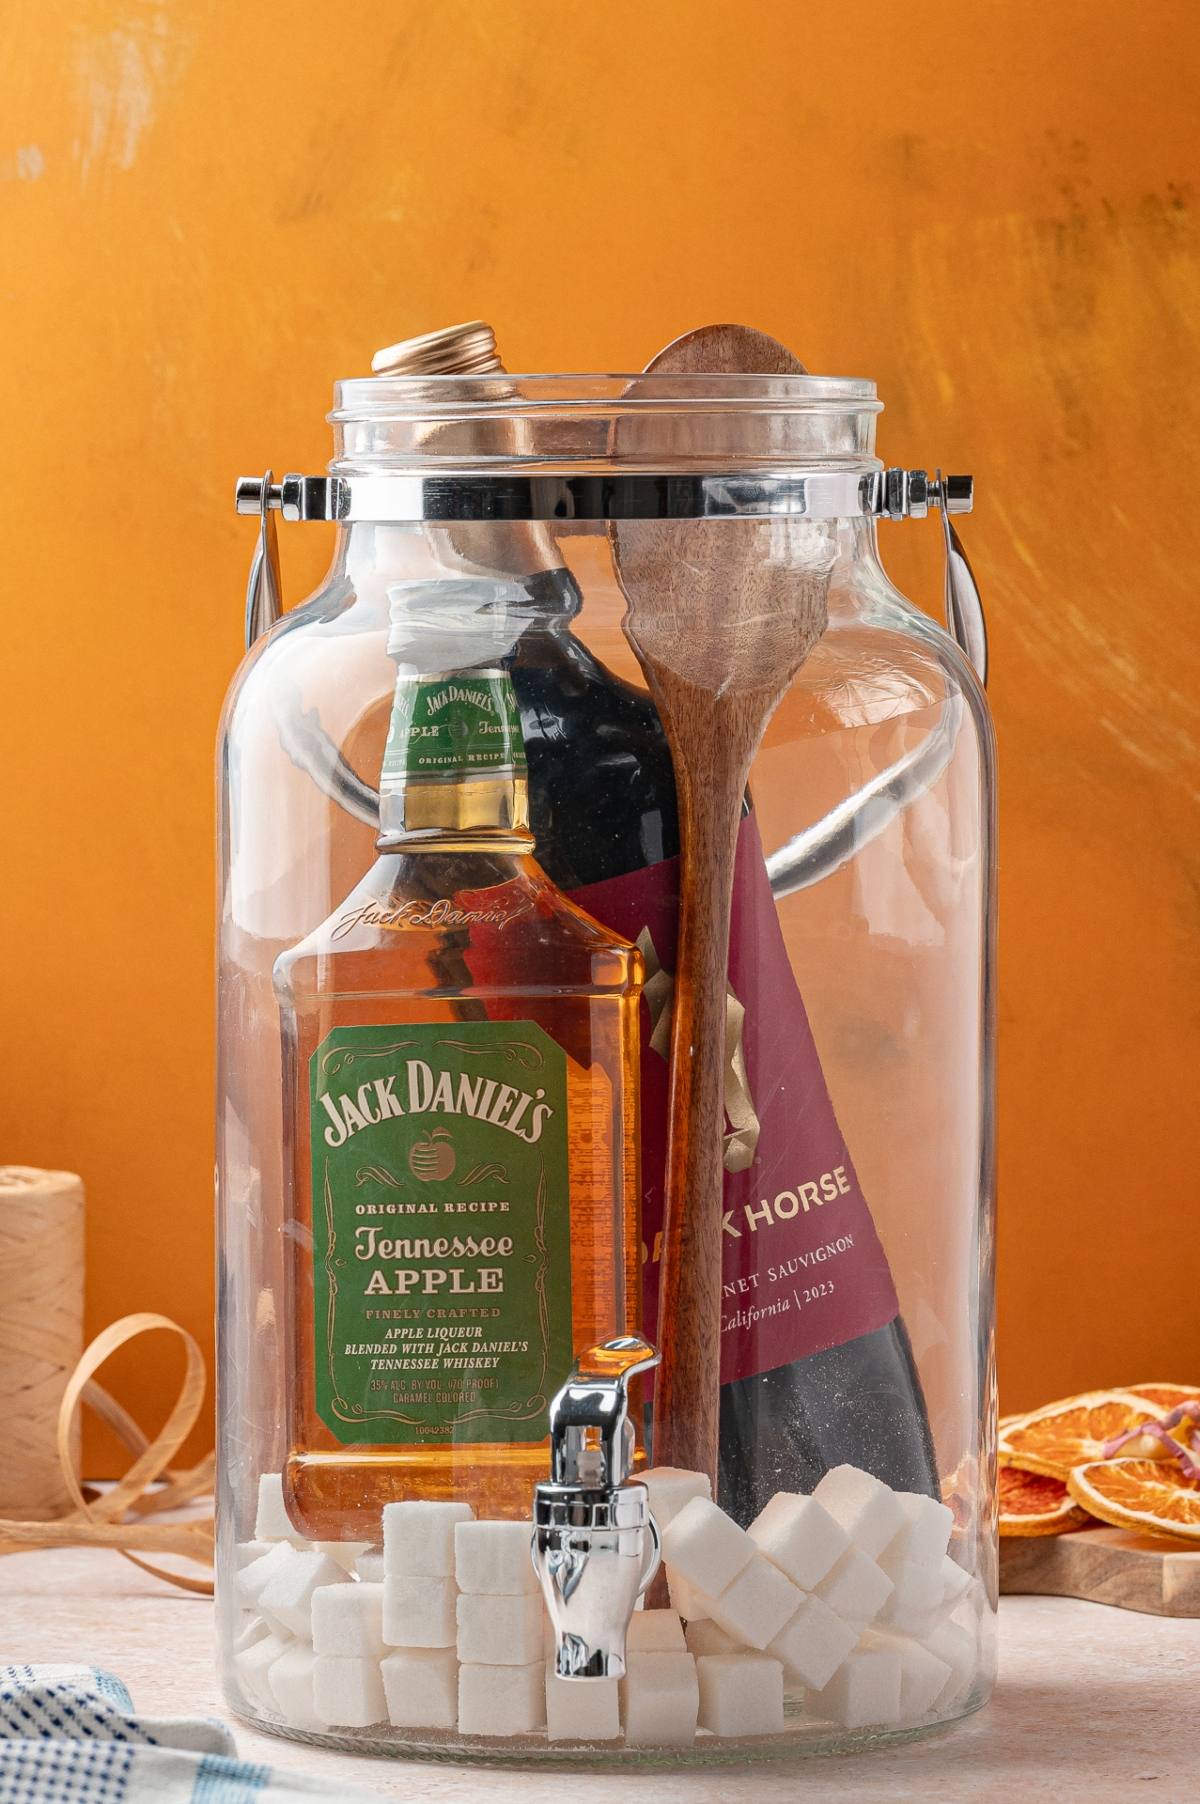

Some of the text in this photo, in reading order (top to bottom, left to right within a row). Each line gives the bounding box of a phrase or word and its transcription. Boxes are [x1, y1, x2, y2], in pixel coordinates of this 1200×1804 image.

[427, 690, 448, 716] JACK
[418, 756, 463, 765] ORIGINAL
[319, 1059, 554, 1148] JACK DANIEL'S
[743, 1165, 851, 1232] HORSE
[355, 1202, 511, 1215] ORIGINAL RECIPE
[354, 1226, 514, 1261] Tennessee
[767, 1233, 856, 1282] SAUVIGNON
[363, 1268, 504, 1296] APPLE
[803, 1280, 835, 1304] 2023
[366, 1308, 501, 1320] FINELY CRAFTED
[384, 1326, 483, 1341] APPLE LIQUEUR
[344, 1341, 529, 1356] BLENDED WITH JACK DANIEL'S
[370, 1357, 500, 1370] TENNESSEE WHISKEY
[411, 1379, 422, 1390] BY
[393, 1391, 476, 1404] CARAMEL COLORED
